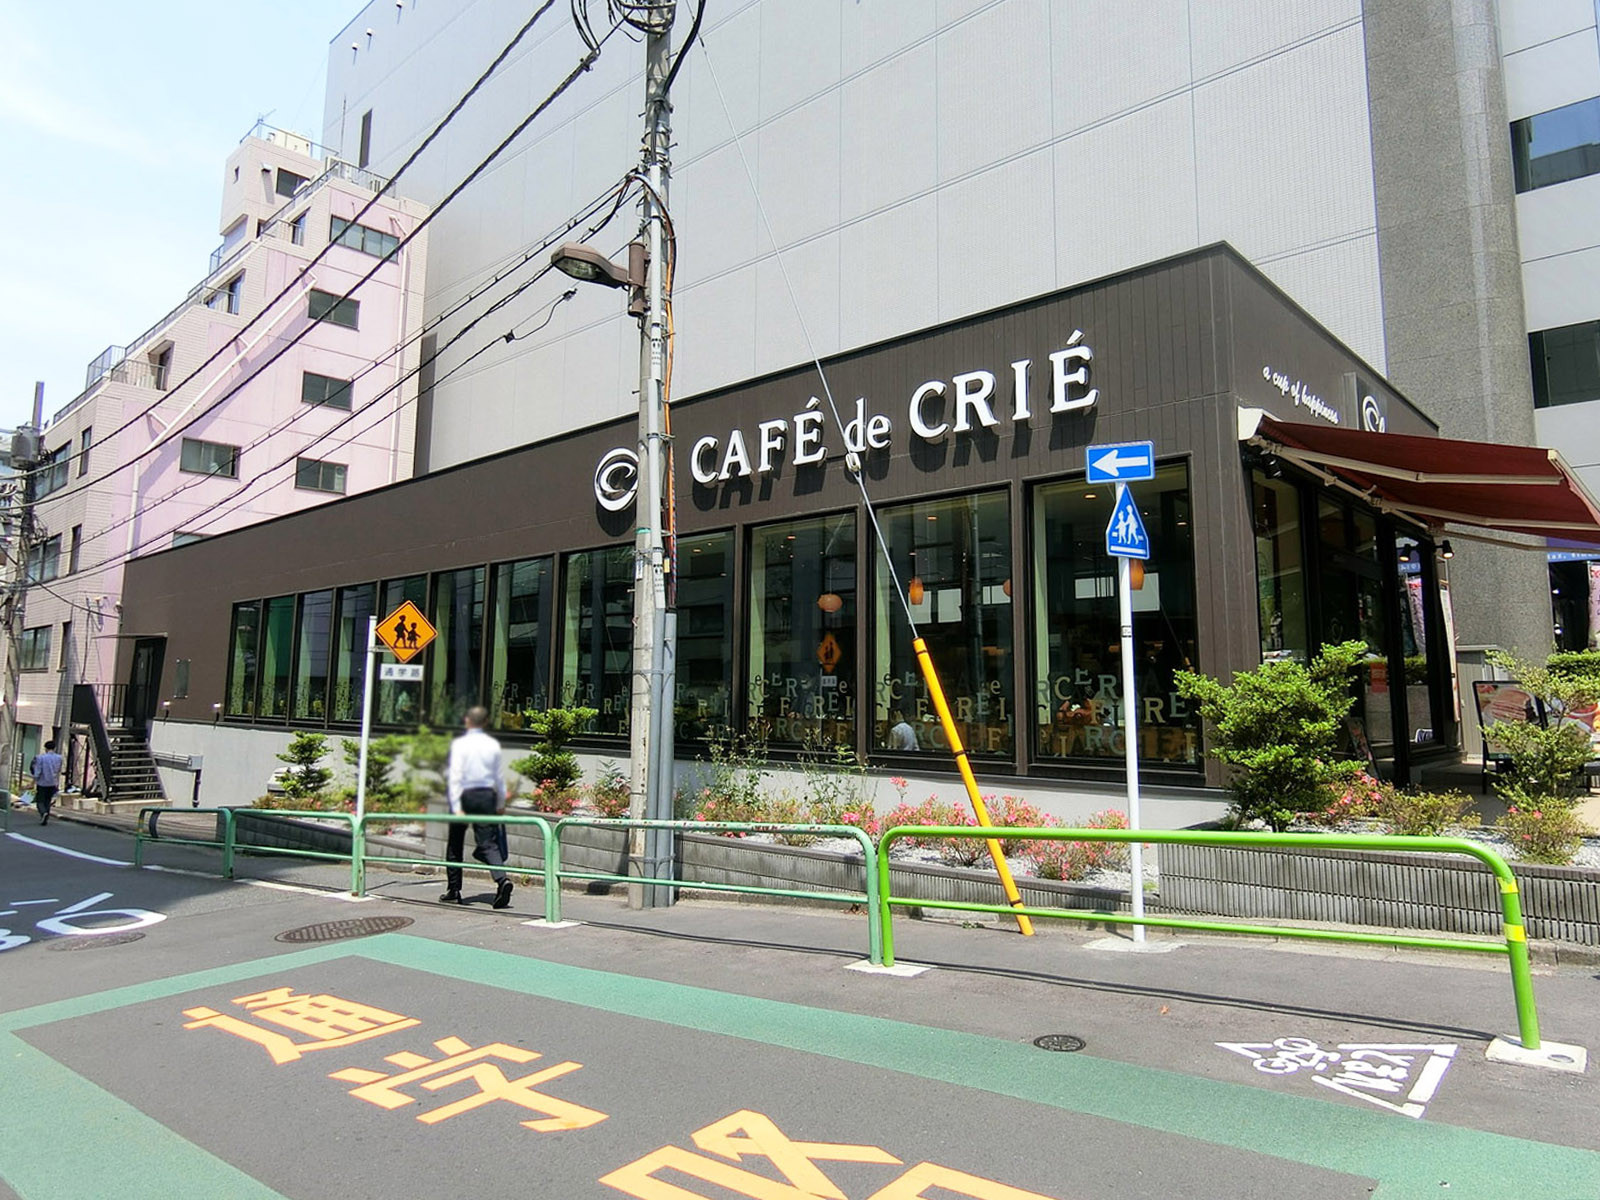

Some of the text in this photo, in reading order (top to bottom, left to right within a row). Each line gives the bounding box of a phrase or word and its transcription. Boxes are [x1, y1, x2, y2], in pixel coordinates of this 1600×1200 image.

[690, 329, 1099, 485] CAFÉ de CRIÉ
[1272, 372, 1289, 396] cup
[1290, 380, 1301, 406] of
[1301, 385, 1339, 425] happiness
